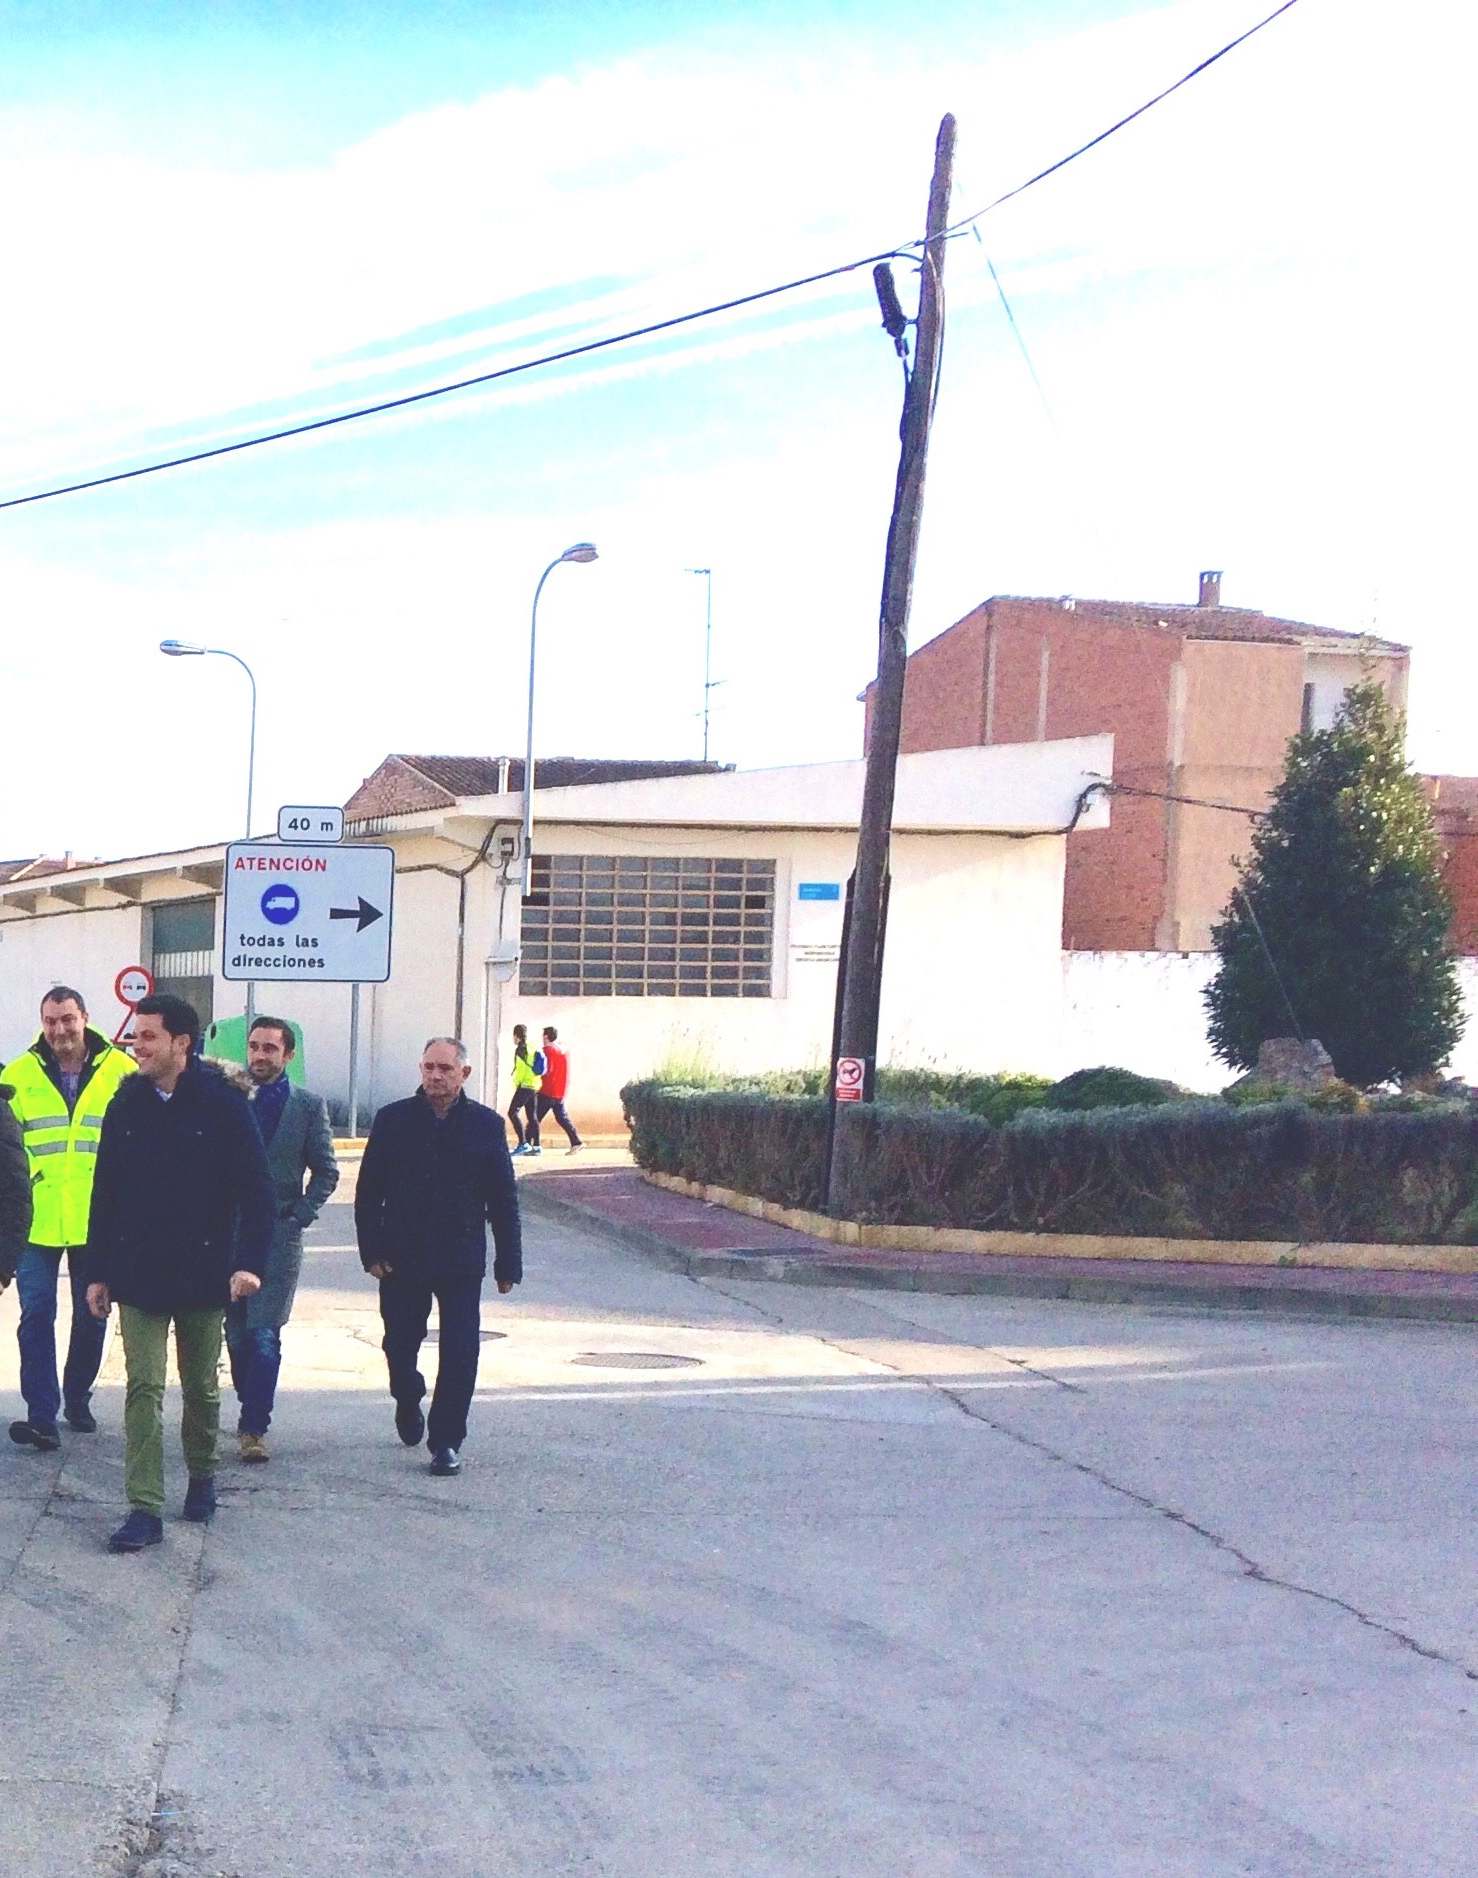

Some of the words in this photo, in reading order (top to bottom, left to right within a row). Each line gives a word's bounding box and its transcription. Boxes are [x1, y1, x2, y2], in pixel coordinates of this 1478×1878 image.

[287, 817, 310, 831] 40
[320, 821, 334, 832] m
[234, 855, 327, 872] ATENCIÓN
[239, 933, 285, 947] todas
[295, 934, 319, 948] las
[231, 954, 325, 968] direcciones
